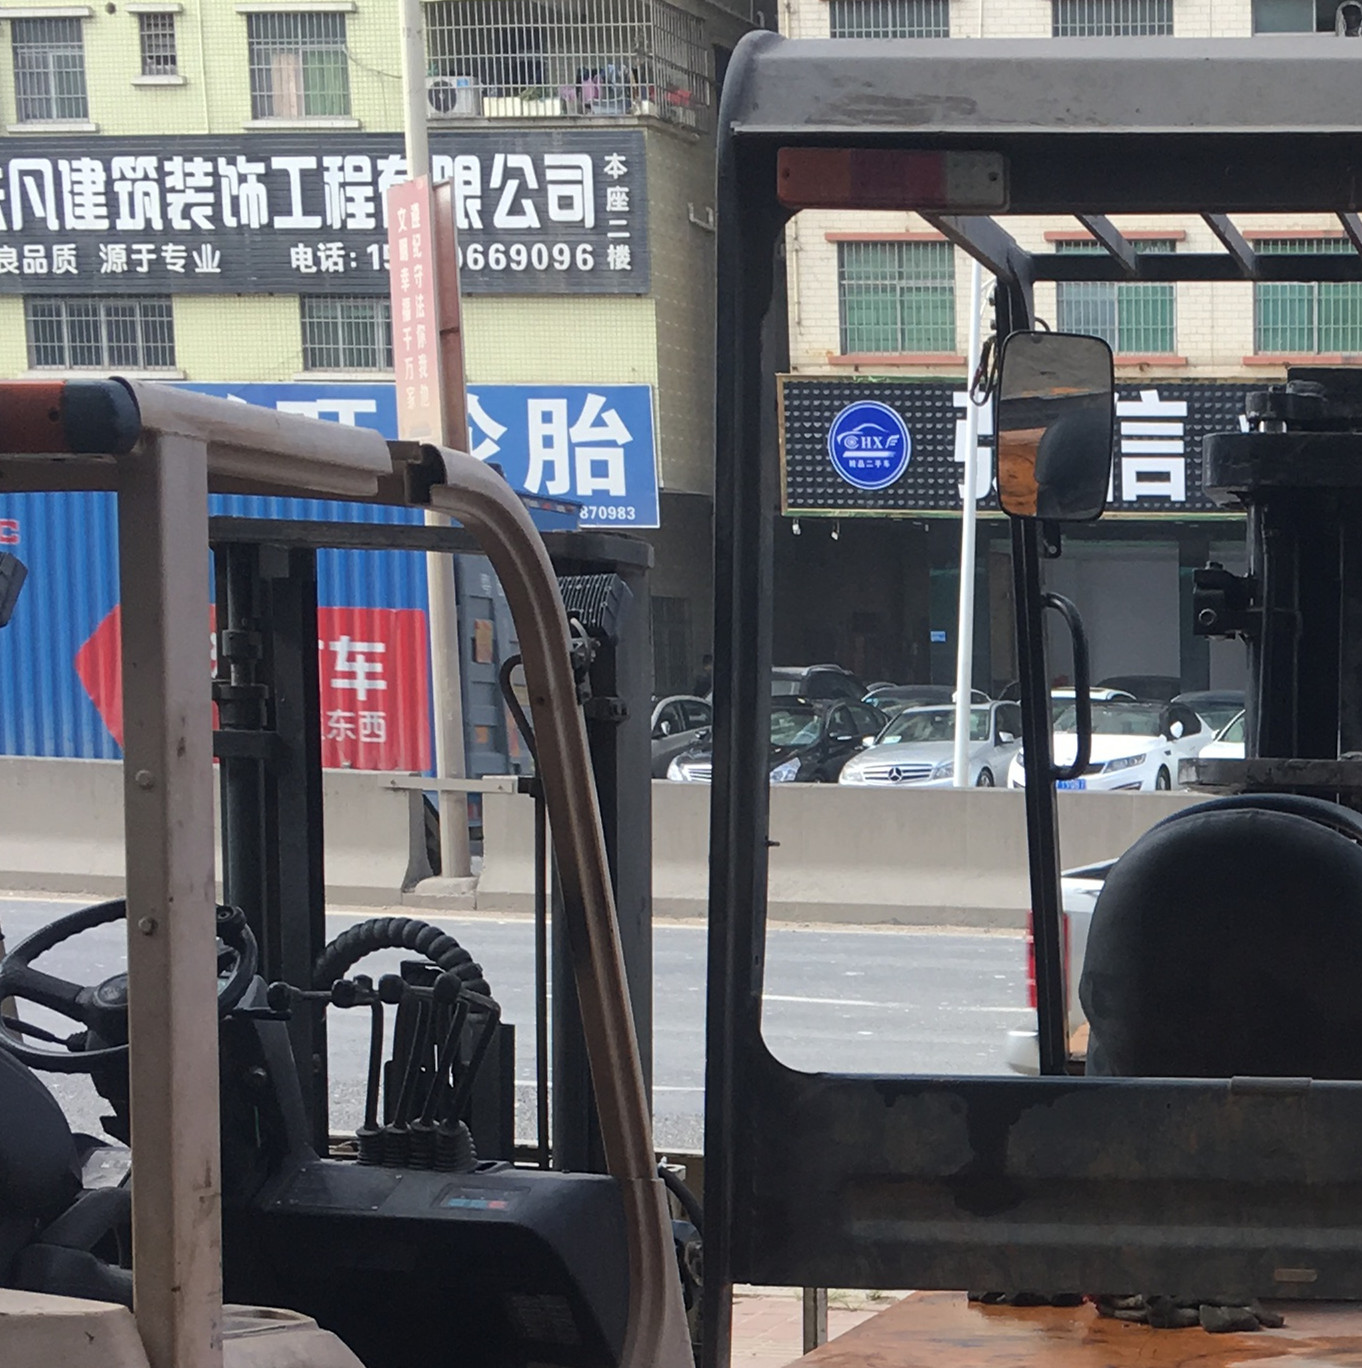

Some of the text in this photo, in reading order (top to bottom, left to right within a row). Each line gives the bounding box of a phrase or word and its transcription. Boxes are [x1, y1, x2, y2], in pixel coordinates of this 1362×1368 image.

[603, 152, 632, 271] 本座二楼
[99, 243, 222, 275] 源于专业
[321, 708, 387, 743] 东西
